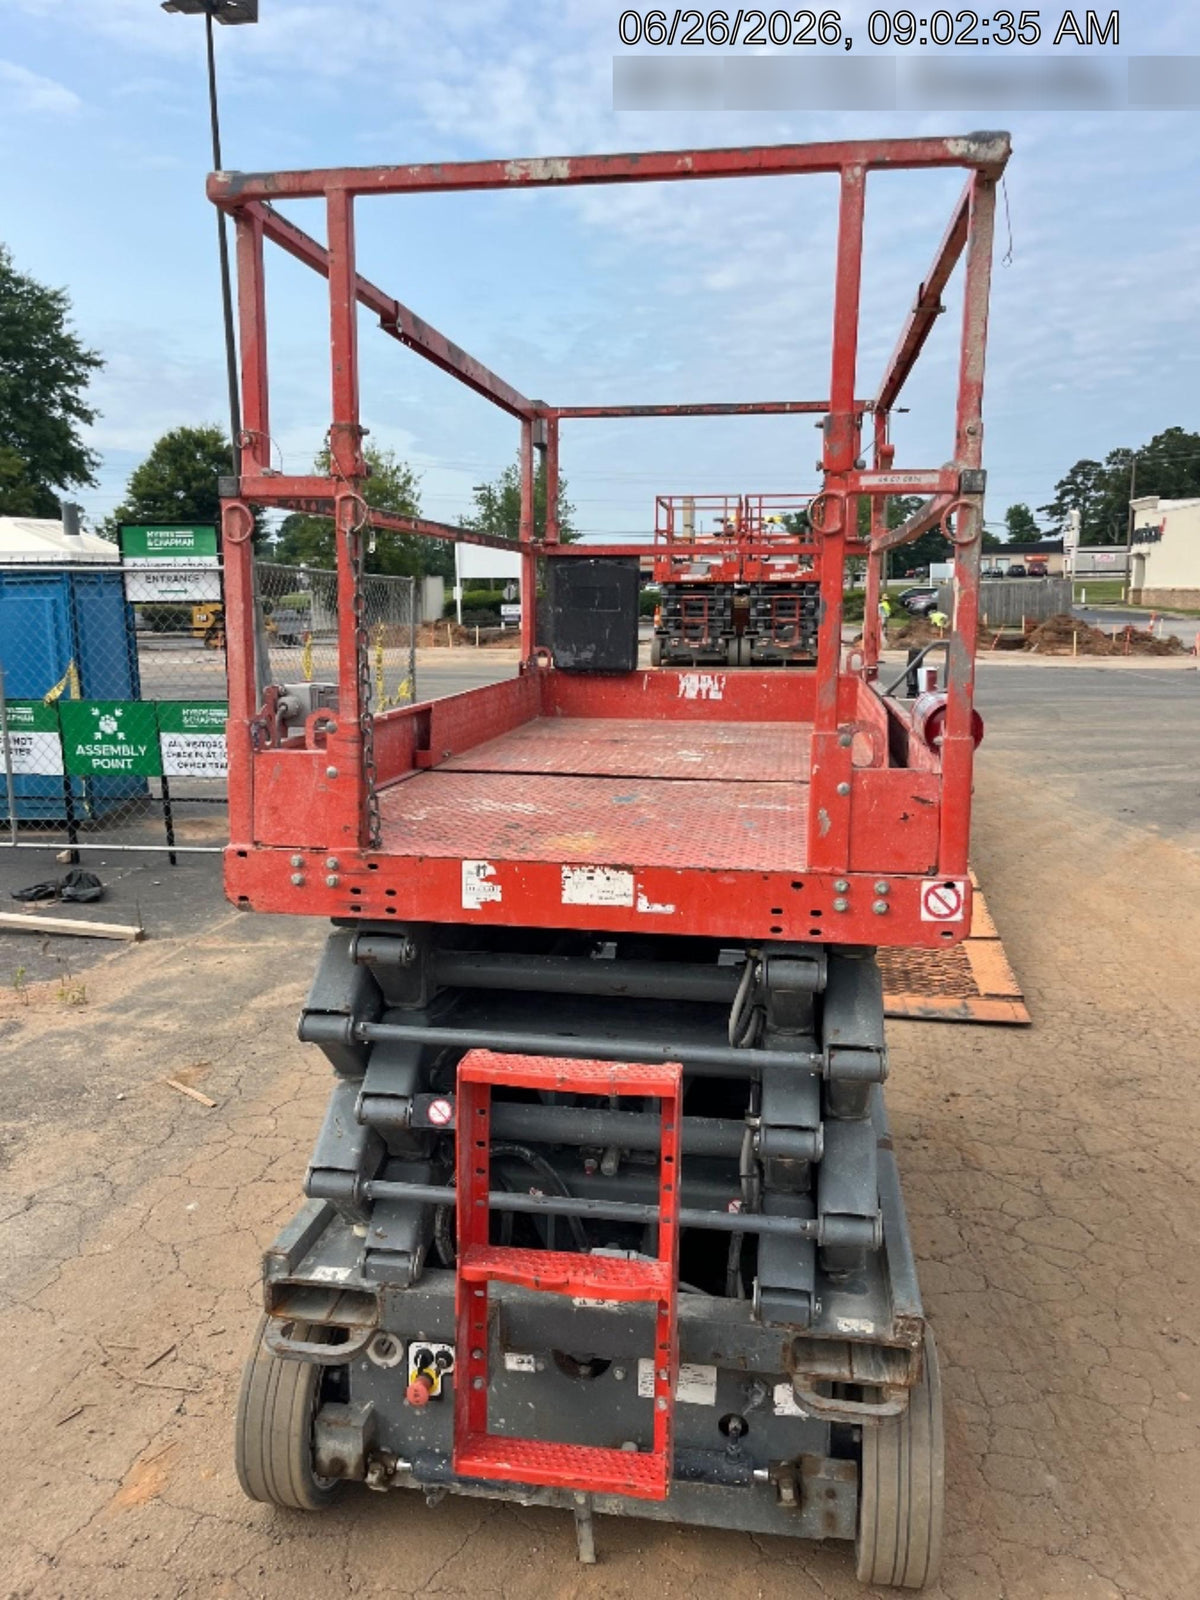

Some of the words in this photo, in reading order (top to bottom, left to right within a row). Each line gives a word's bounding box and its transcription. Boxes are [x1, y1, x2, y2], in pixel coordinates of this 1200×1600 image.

[145, 574, 200, 584] ENTRANCE
[75, 744, 147, 756] ASSEMBLY
[91, 758, 134, 769] POINT
